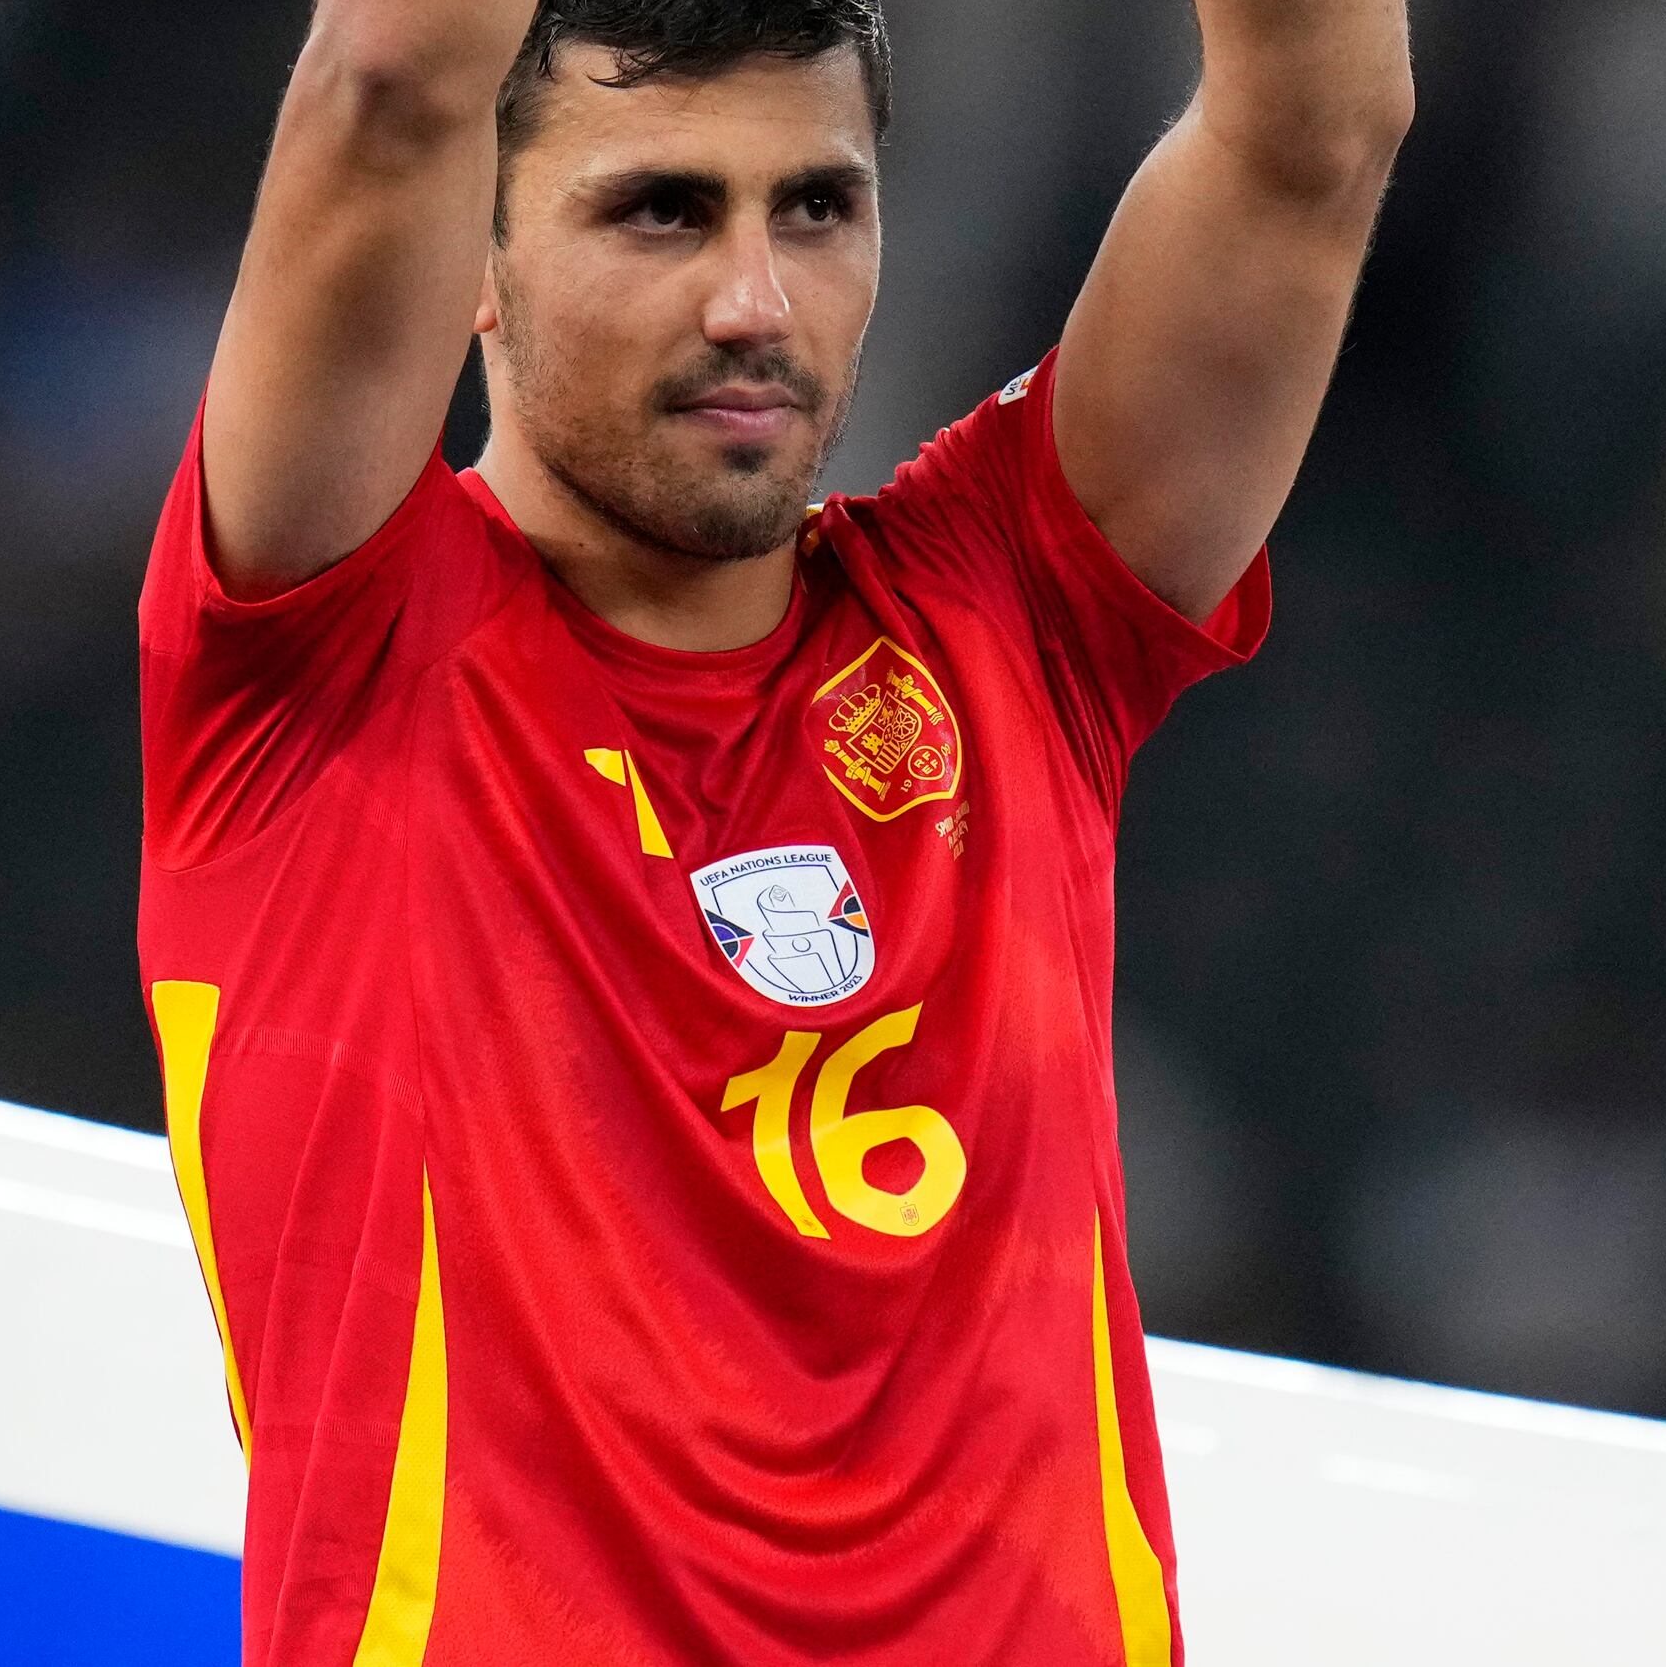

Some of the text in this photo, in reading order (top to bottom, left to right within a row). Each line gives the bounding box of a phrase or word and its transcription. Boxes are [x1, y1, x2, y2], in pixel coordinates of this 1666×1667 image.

[699, 853, 832, 887] UEFA NATIONS LEAGUE
[788, 974, 863, 1003] WINNER 2023
[720, 1000, 967, 1240] 16
